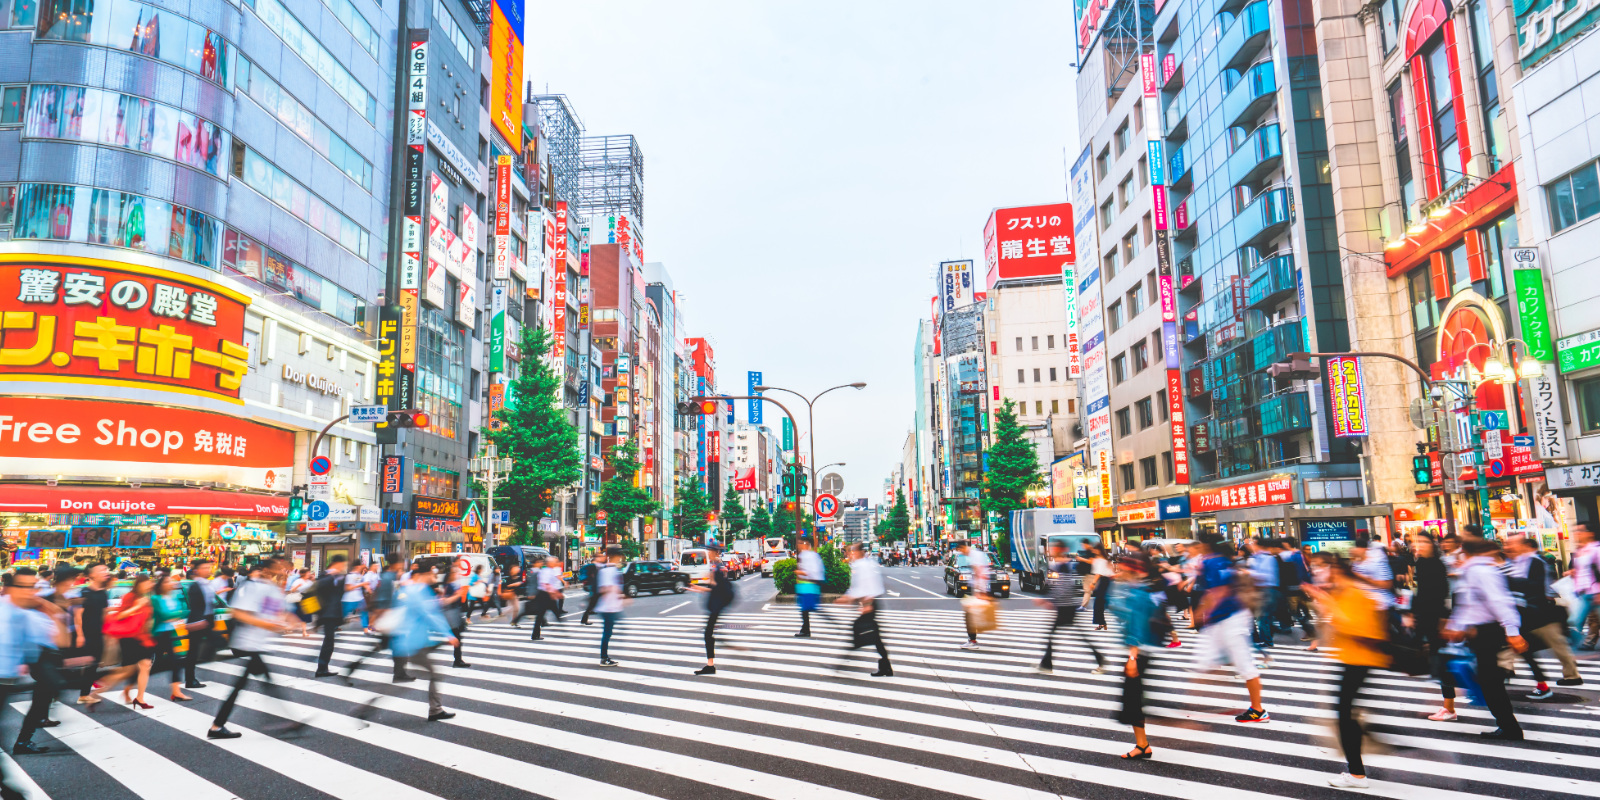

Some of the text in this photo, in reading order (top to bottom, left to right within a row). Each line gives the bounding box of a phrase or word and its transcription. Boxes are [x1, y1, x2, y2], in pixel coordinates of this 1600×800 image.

[500, 156, 509, 164] 8F
[556, 208, 566, 258] カラオケ
[1007, 215, 1061, 231] クスリの
[1000, 235, 1072, 260] 龍生堂
[17, 267, 218, 328] 驚安の殿堂
[404, 297, 412, 354] アラビアンロック
[1524, 286, 1546, 359] カワノ・クォーク
[492, 328, 502, 354] レイク
[1068, 333, 1080, 375] 三平本館
[1560, 340, 1571, 348] 3F
[282, 364, 343, 395] Don Quijote
[1331, 363, 1346, 433] ネットカフェ
[1343, 360, 1363, 431] ネットカフェ
[352, 407, 385, 415] 歌舞伎町
[1538, 381, 1560, 457] カワノ・トラスト
[94, 419, 184, 454] Shop
[193, 428, 248, 458] 免税店
[1171, 377, 1188, 474] クスリの龍生堂薬局
[386, 465, 398, 492] ダイコク
[60, 499, 156, 513] Don Quijote
[256, 504, 271, 513] Don
[1200, 484, 1267, 507] クスリの龍生堂薬局
[311, 505, 321, 518] P
[1306, 521, 1348, 529] SUBNADE
